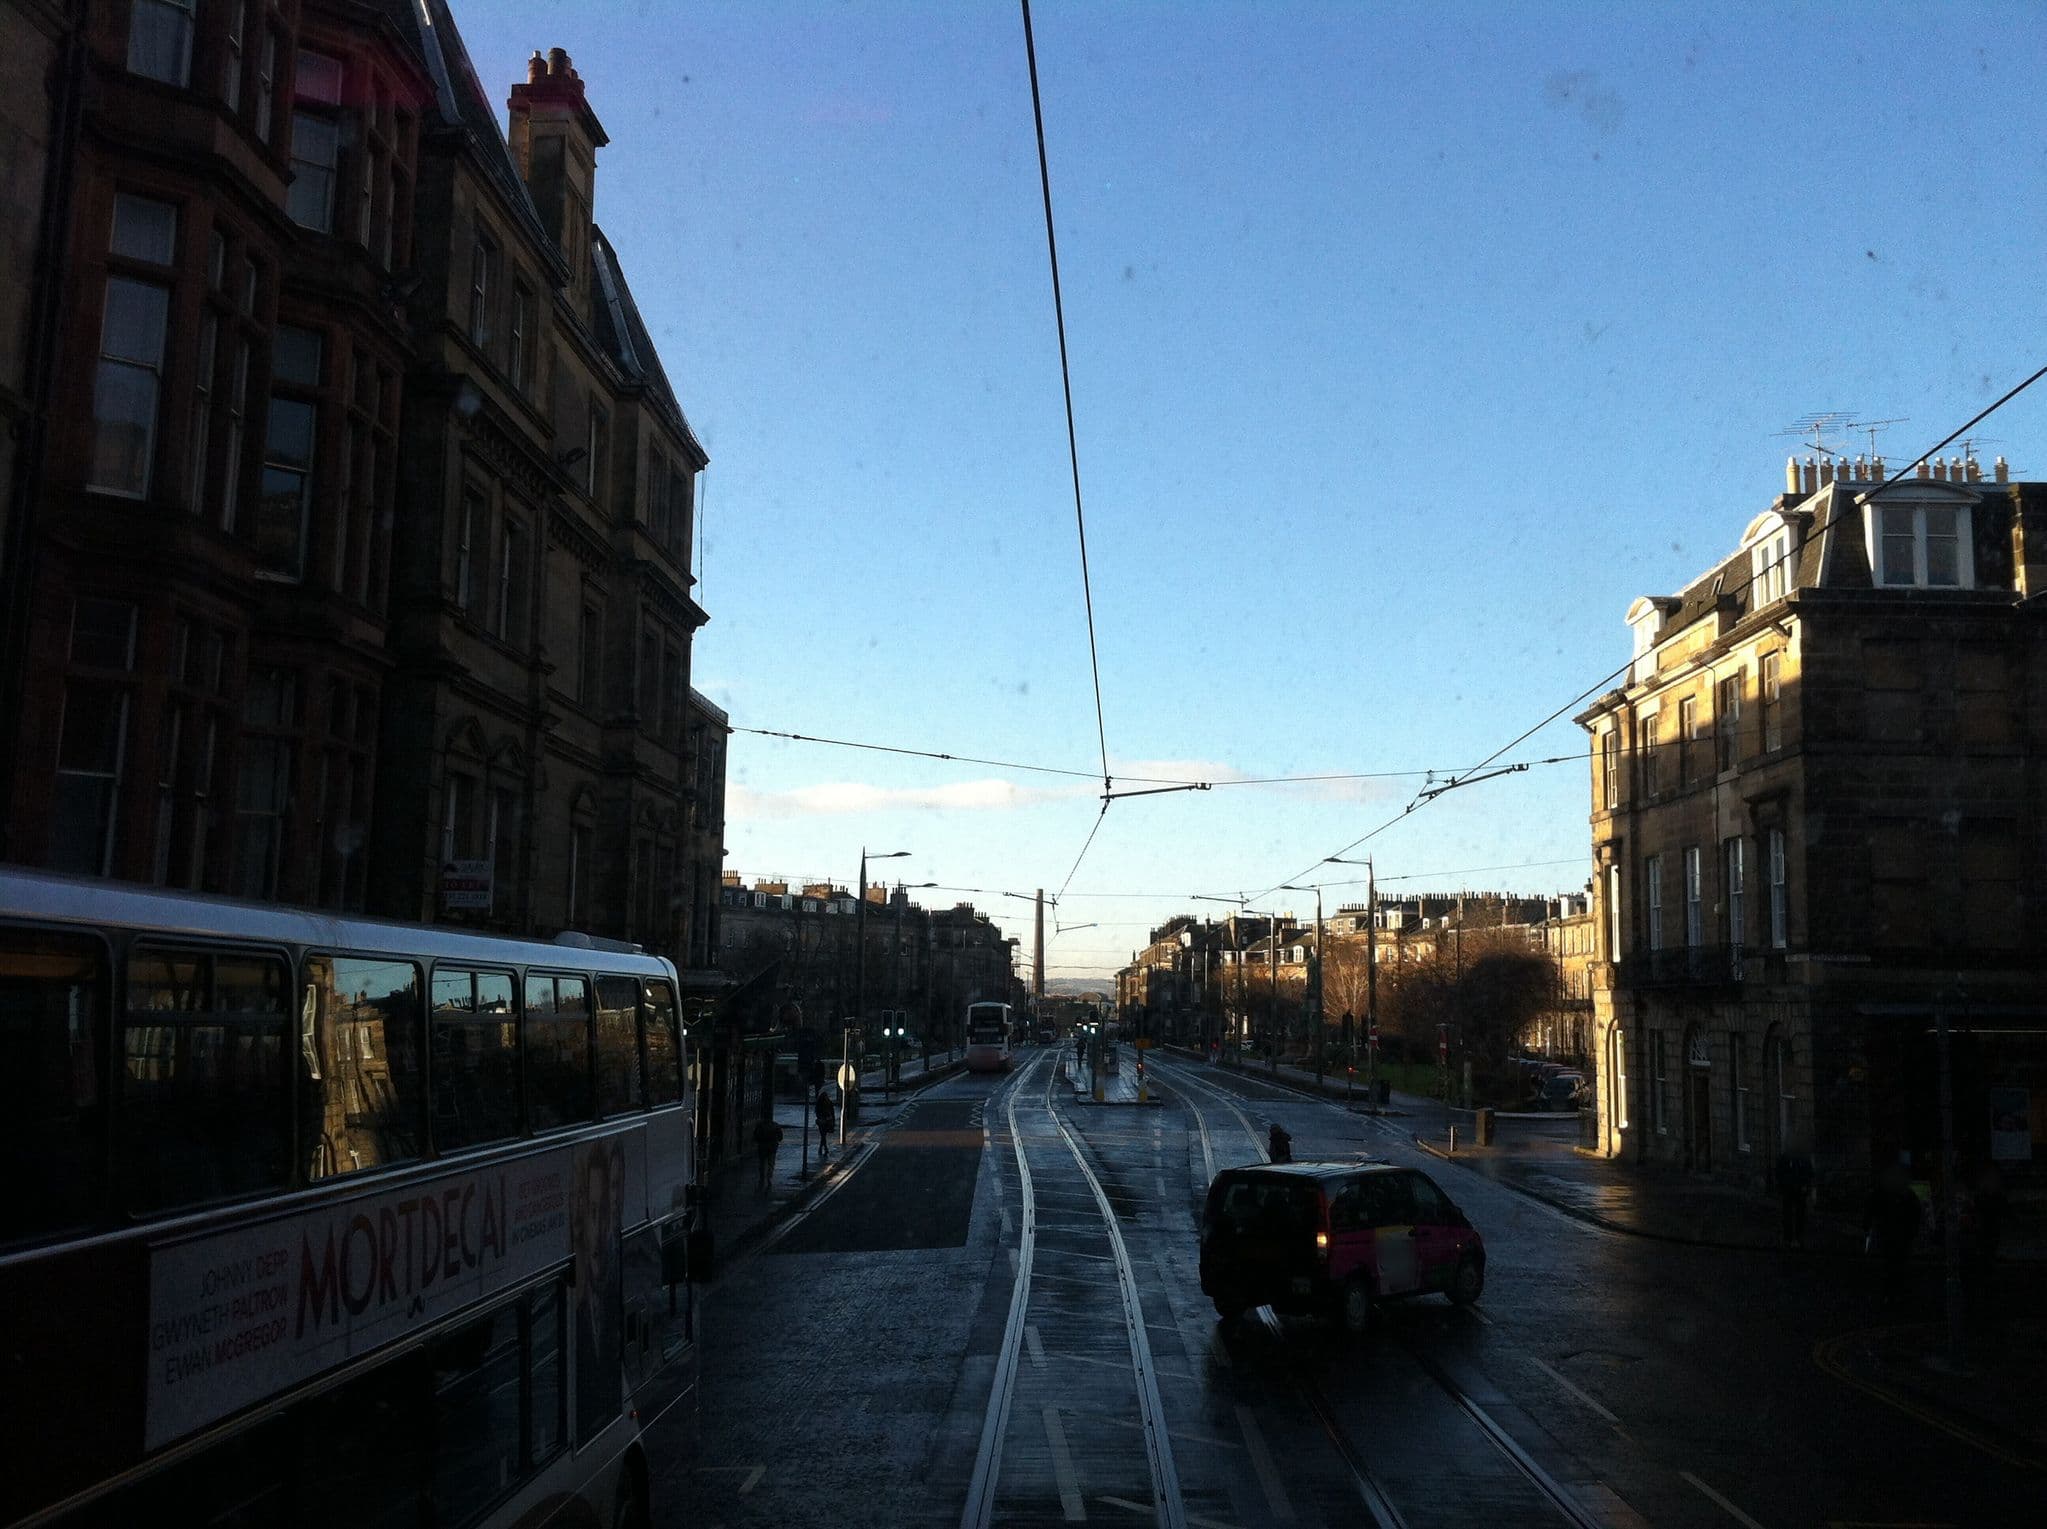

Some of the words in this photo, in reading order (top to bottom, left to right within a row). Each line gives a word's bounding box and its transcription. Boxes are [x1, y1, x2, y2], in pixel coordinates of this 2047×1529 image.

[200, 1259, 252, 1298] JOHNNY
[256, 1249, 288, 1280] DEPP
[296, 1176, 505, 1338] MORTDECAI
[153, 1302, 230, 1350] GWYNETH
[167, 1344, 213, 1384] EWAN
